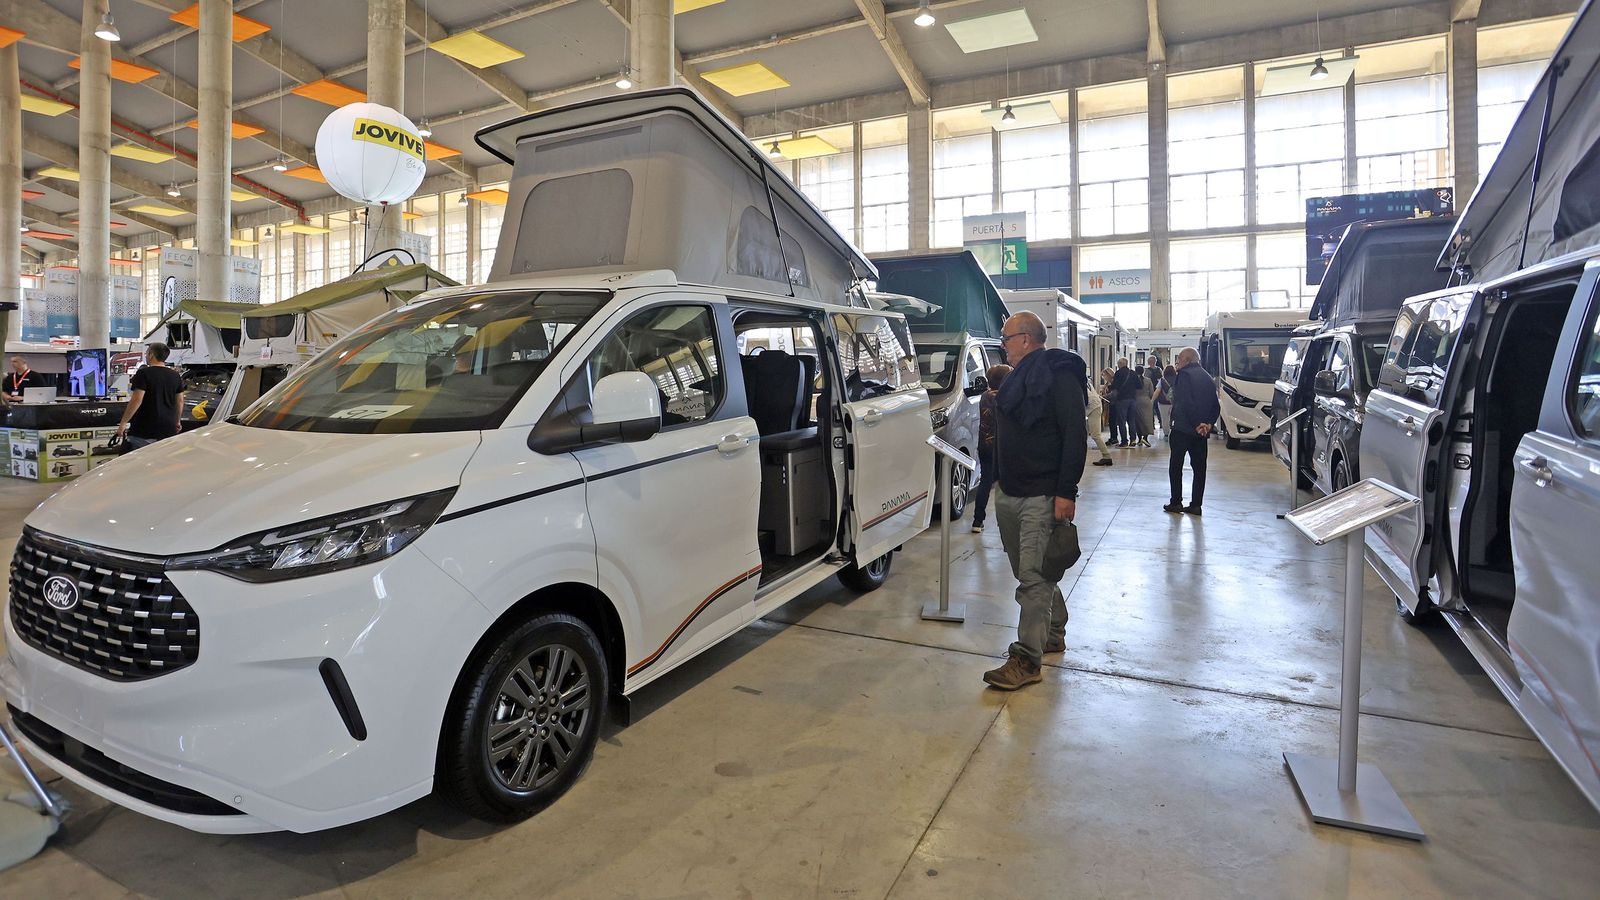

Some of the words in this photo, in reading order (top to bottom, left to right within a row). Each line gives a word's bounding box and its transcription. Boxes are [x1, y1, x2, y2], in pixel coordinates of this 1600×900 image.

[355, 123, 423, 156] JOVIVE
[972, 224, 1006, 235] PUERTA
[164, 251, 194, 262] IFECA
[233, 261, 259, 270] IFECA
[48, 272, 76, 281] IFECA
[1108, 276, 1141, 287] ASEOS
[114, 279, 138, 287] IFECA
[48, 432, 79, 440] JOVIVE
[881, 491, 911, 512] PANAMA
[47, 579, 72, 606] Ford
